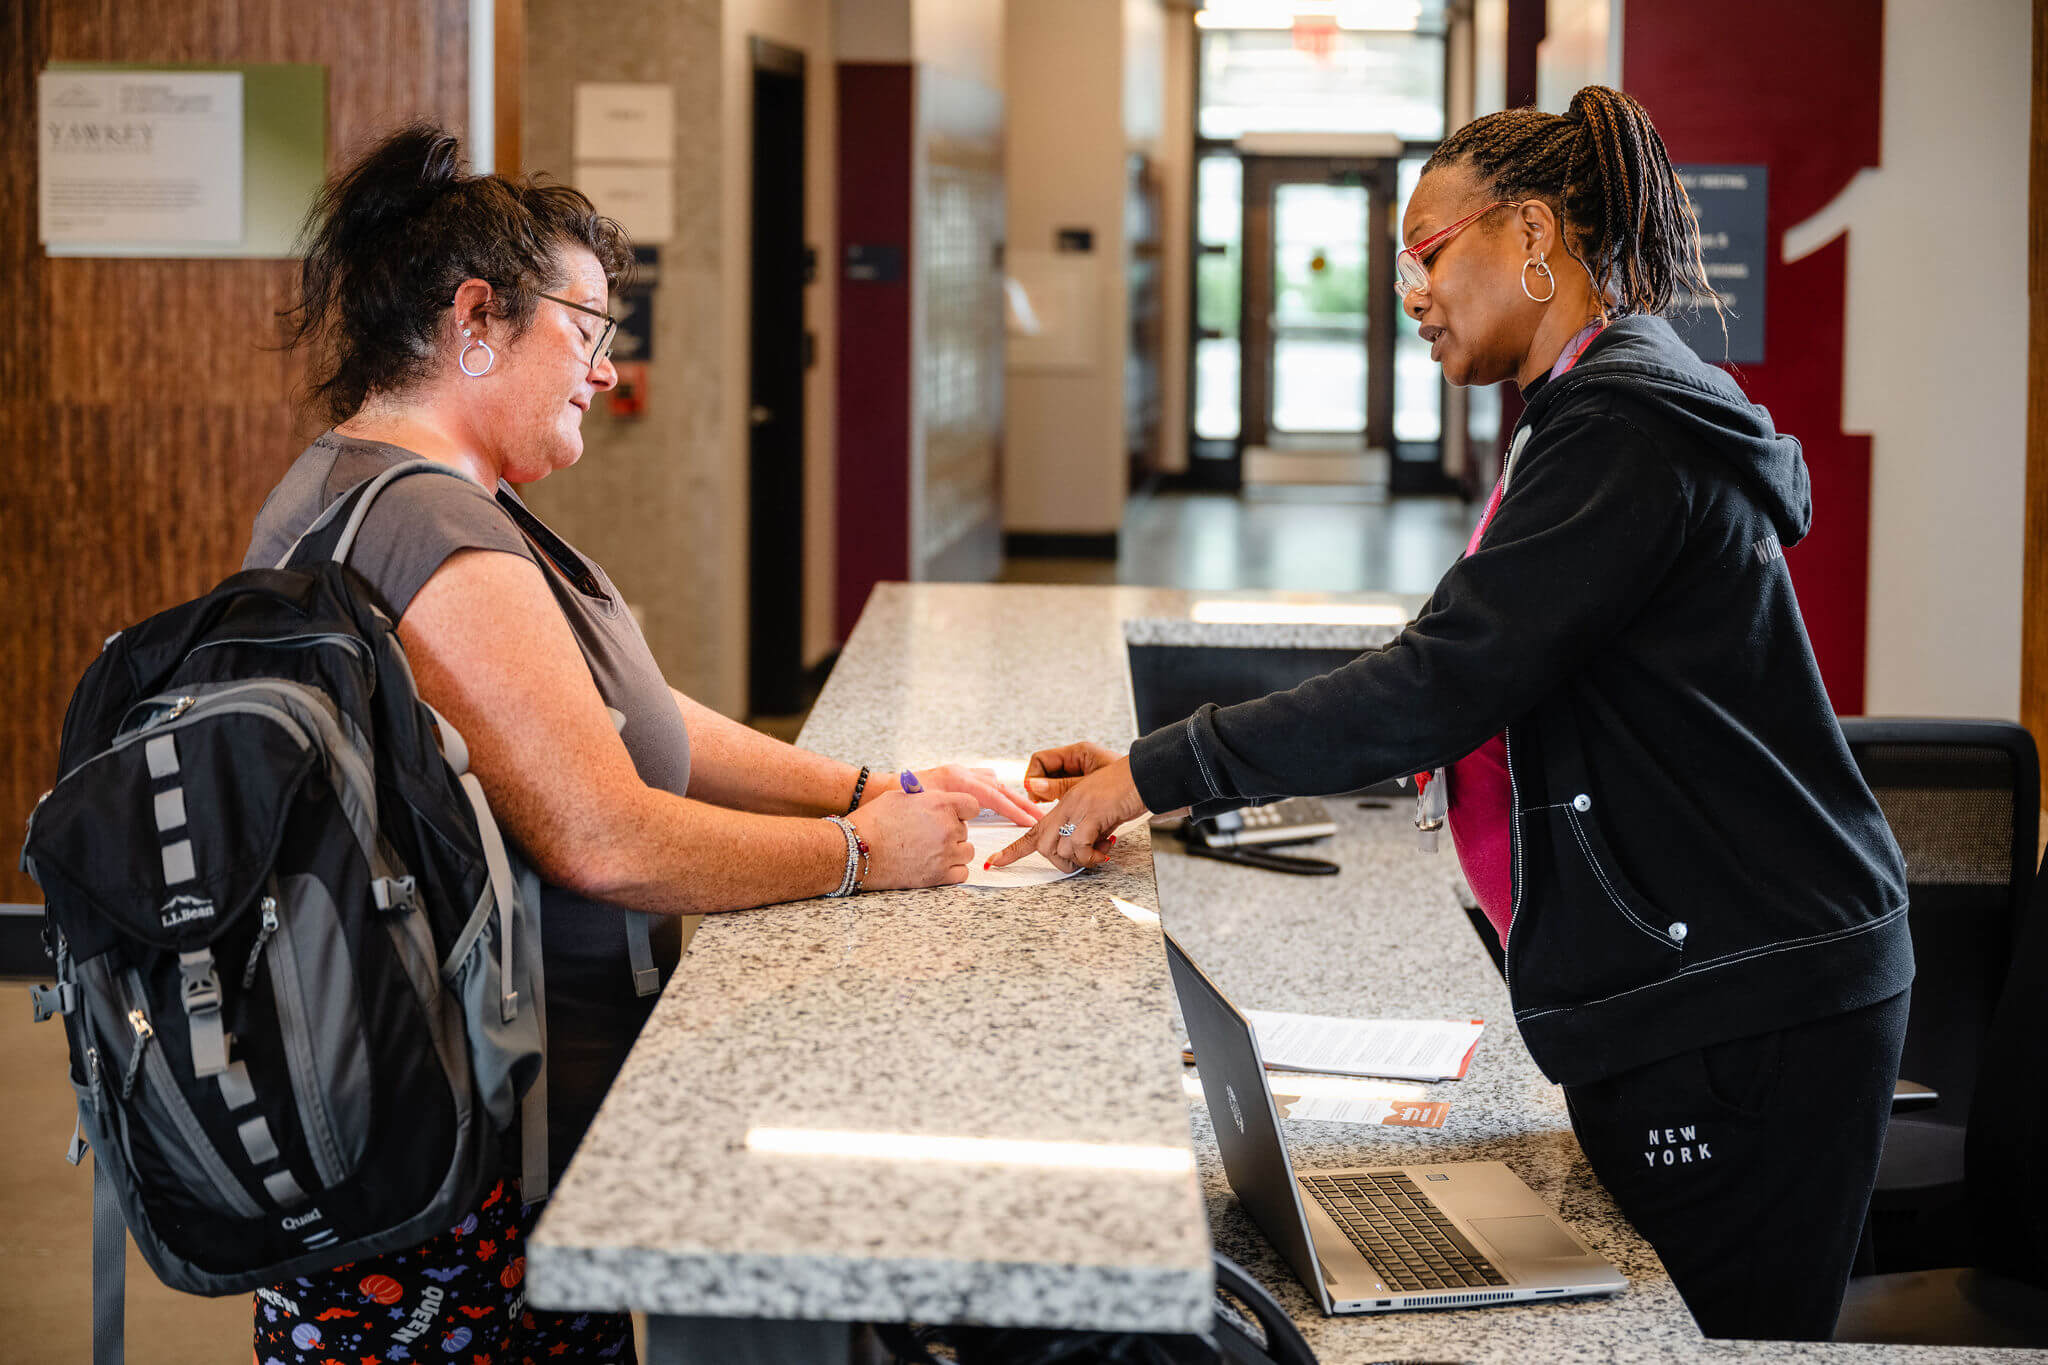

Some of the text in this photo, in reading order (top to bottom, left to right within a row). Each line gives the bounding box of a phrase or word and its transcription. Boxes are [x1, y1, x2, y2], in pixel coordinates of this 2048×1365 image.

[1648, 1125, 1696, 1145] NEW
[1644, 1143, 1712, 1167] YORK
[281, 1207, 322, 1230] Quad
[390, 1286, 444, 1344] QUEEN
